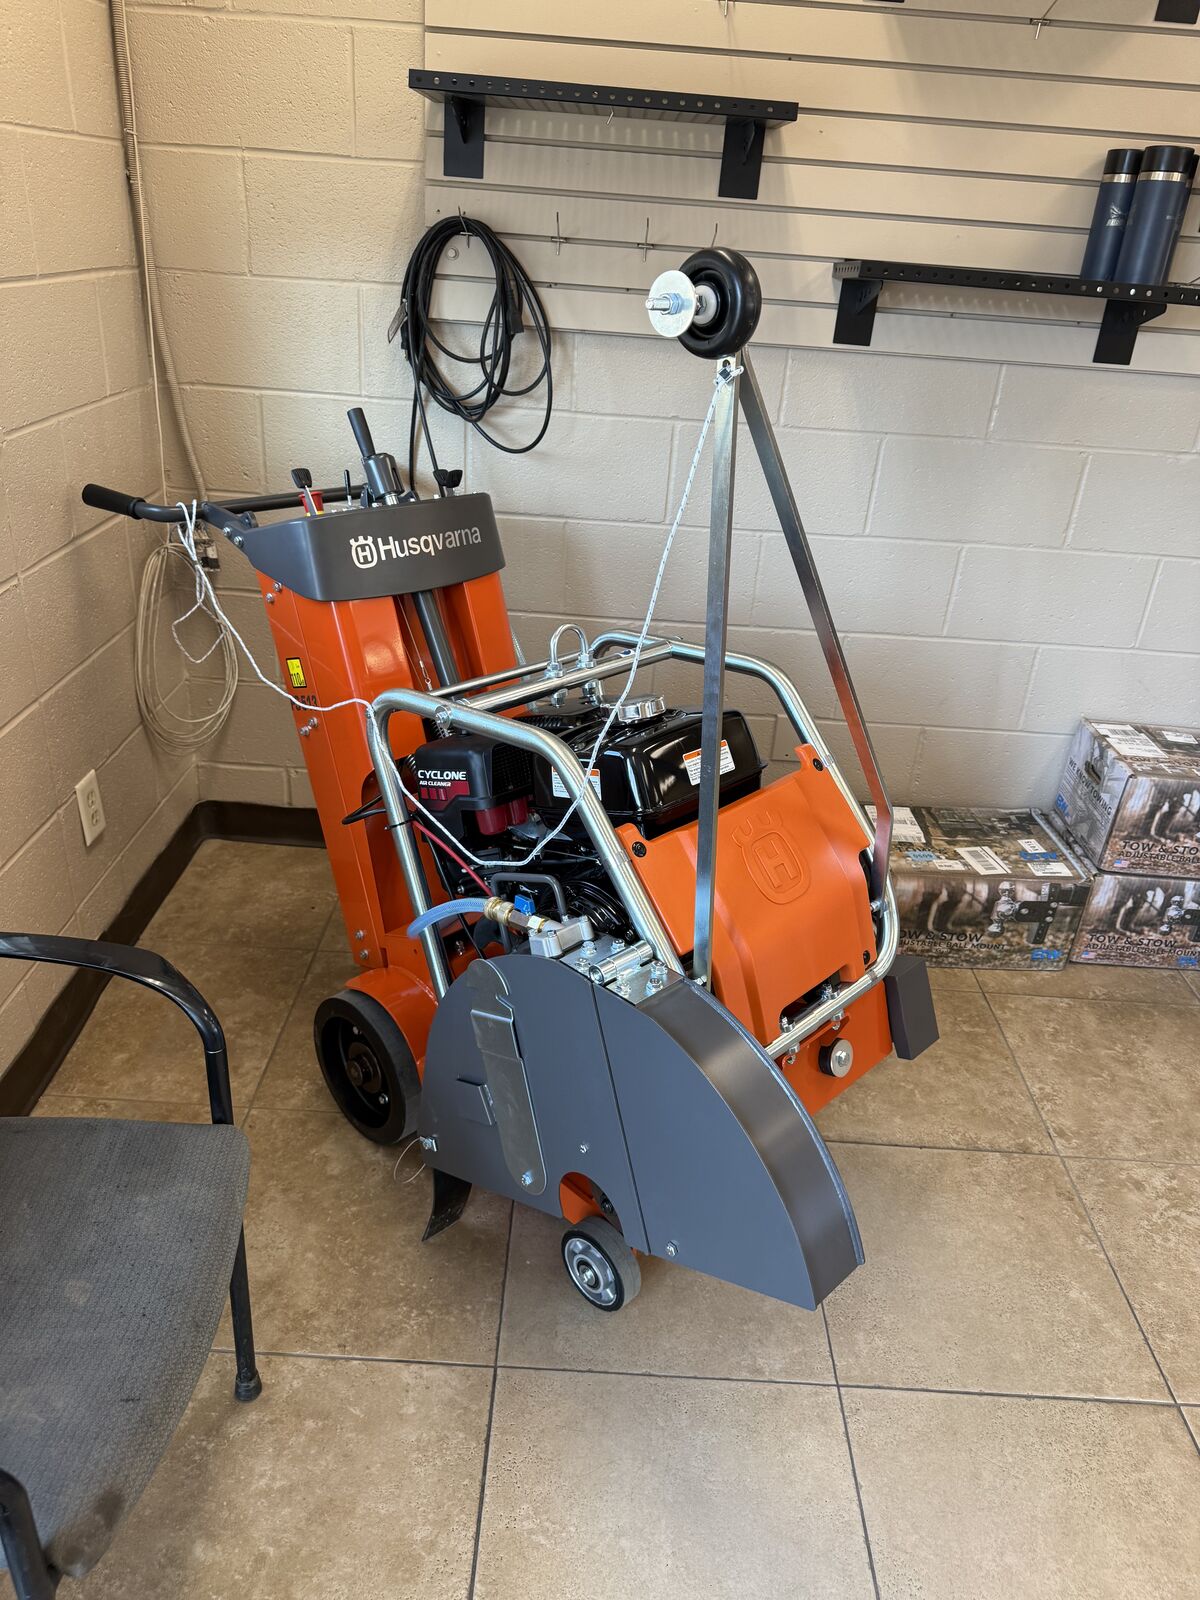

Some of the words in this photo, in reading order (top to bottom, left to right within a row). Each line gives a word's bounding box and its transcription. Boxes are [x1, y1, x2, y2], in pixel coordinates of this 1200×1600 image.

[377, 526, 482, 561] Husqvarna
[417, 769, 467, 781] CYCLONE
[1089, 786, 1113, 816] TOWING
[1122, 840, 1155, 852] TOW
[1158, 844, 1168, 853] &
[1172, 845, 1200, 856] STO
[1118, 850, 1178, 862] ADJUSTABLE
[900, 929, 922, 940] OW
[926, 931, 936, 941] &
[940, 931, 984, 943] STOW
[1088, 934, 1120, 944] TOW
[1124, 937, 1133, 945] &
[1138, 937, 1177, 948] STOW
[899, 938, 946, 948] JUSTABLE
[946, 941, 969, 949] BALL
[971, 943, 1007, 951] MOUNT
[1084, 943, 1143, 954] ADJUSTABLE
[1144, 947, 1168, 955] BALL
